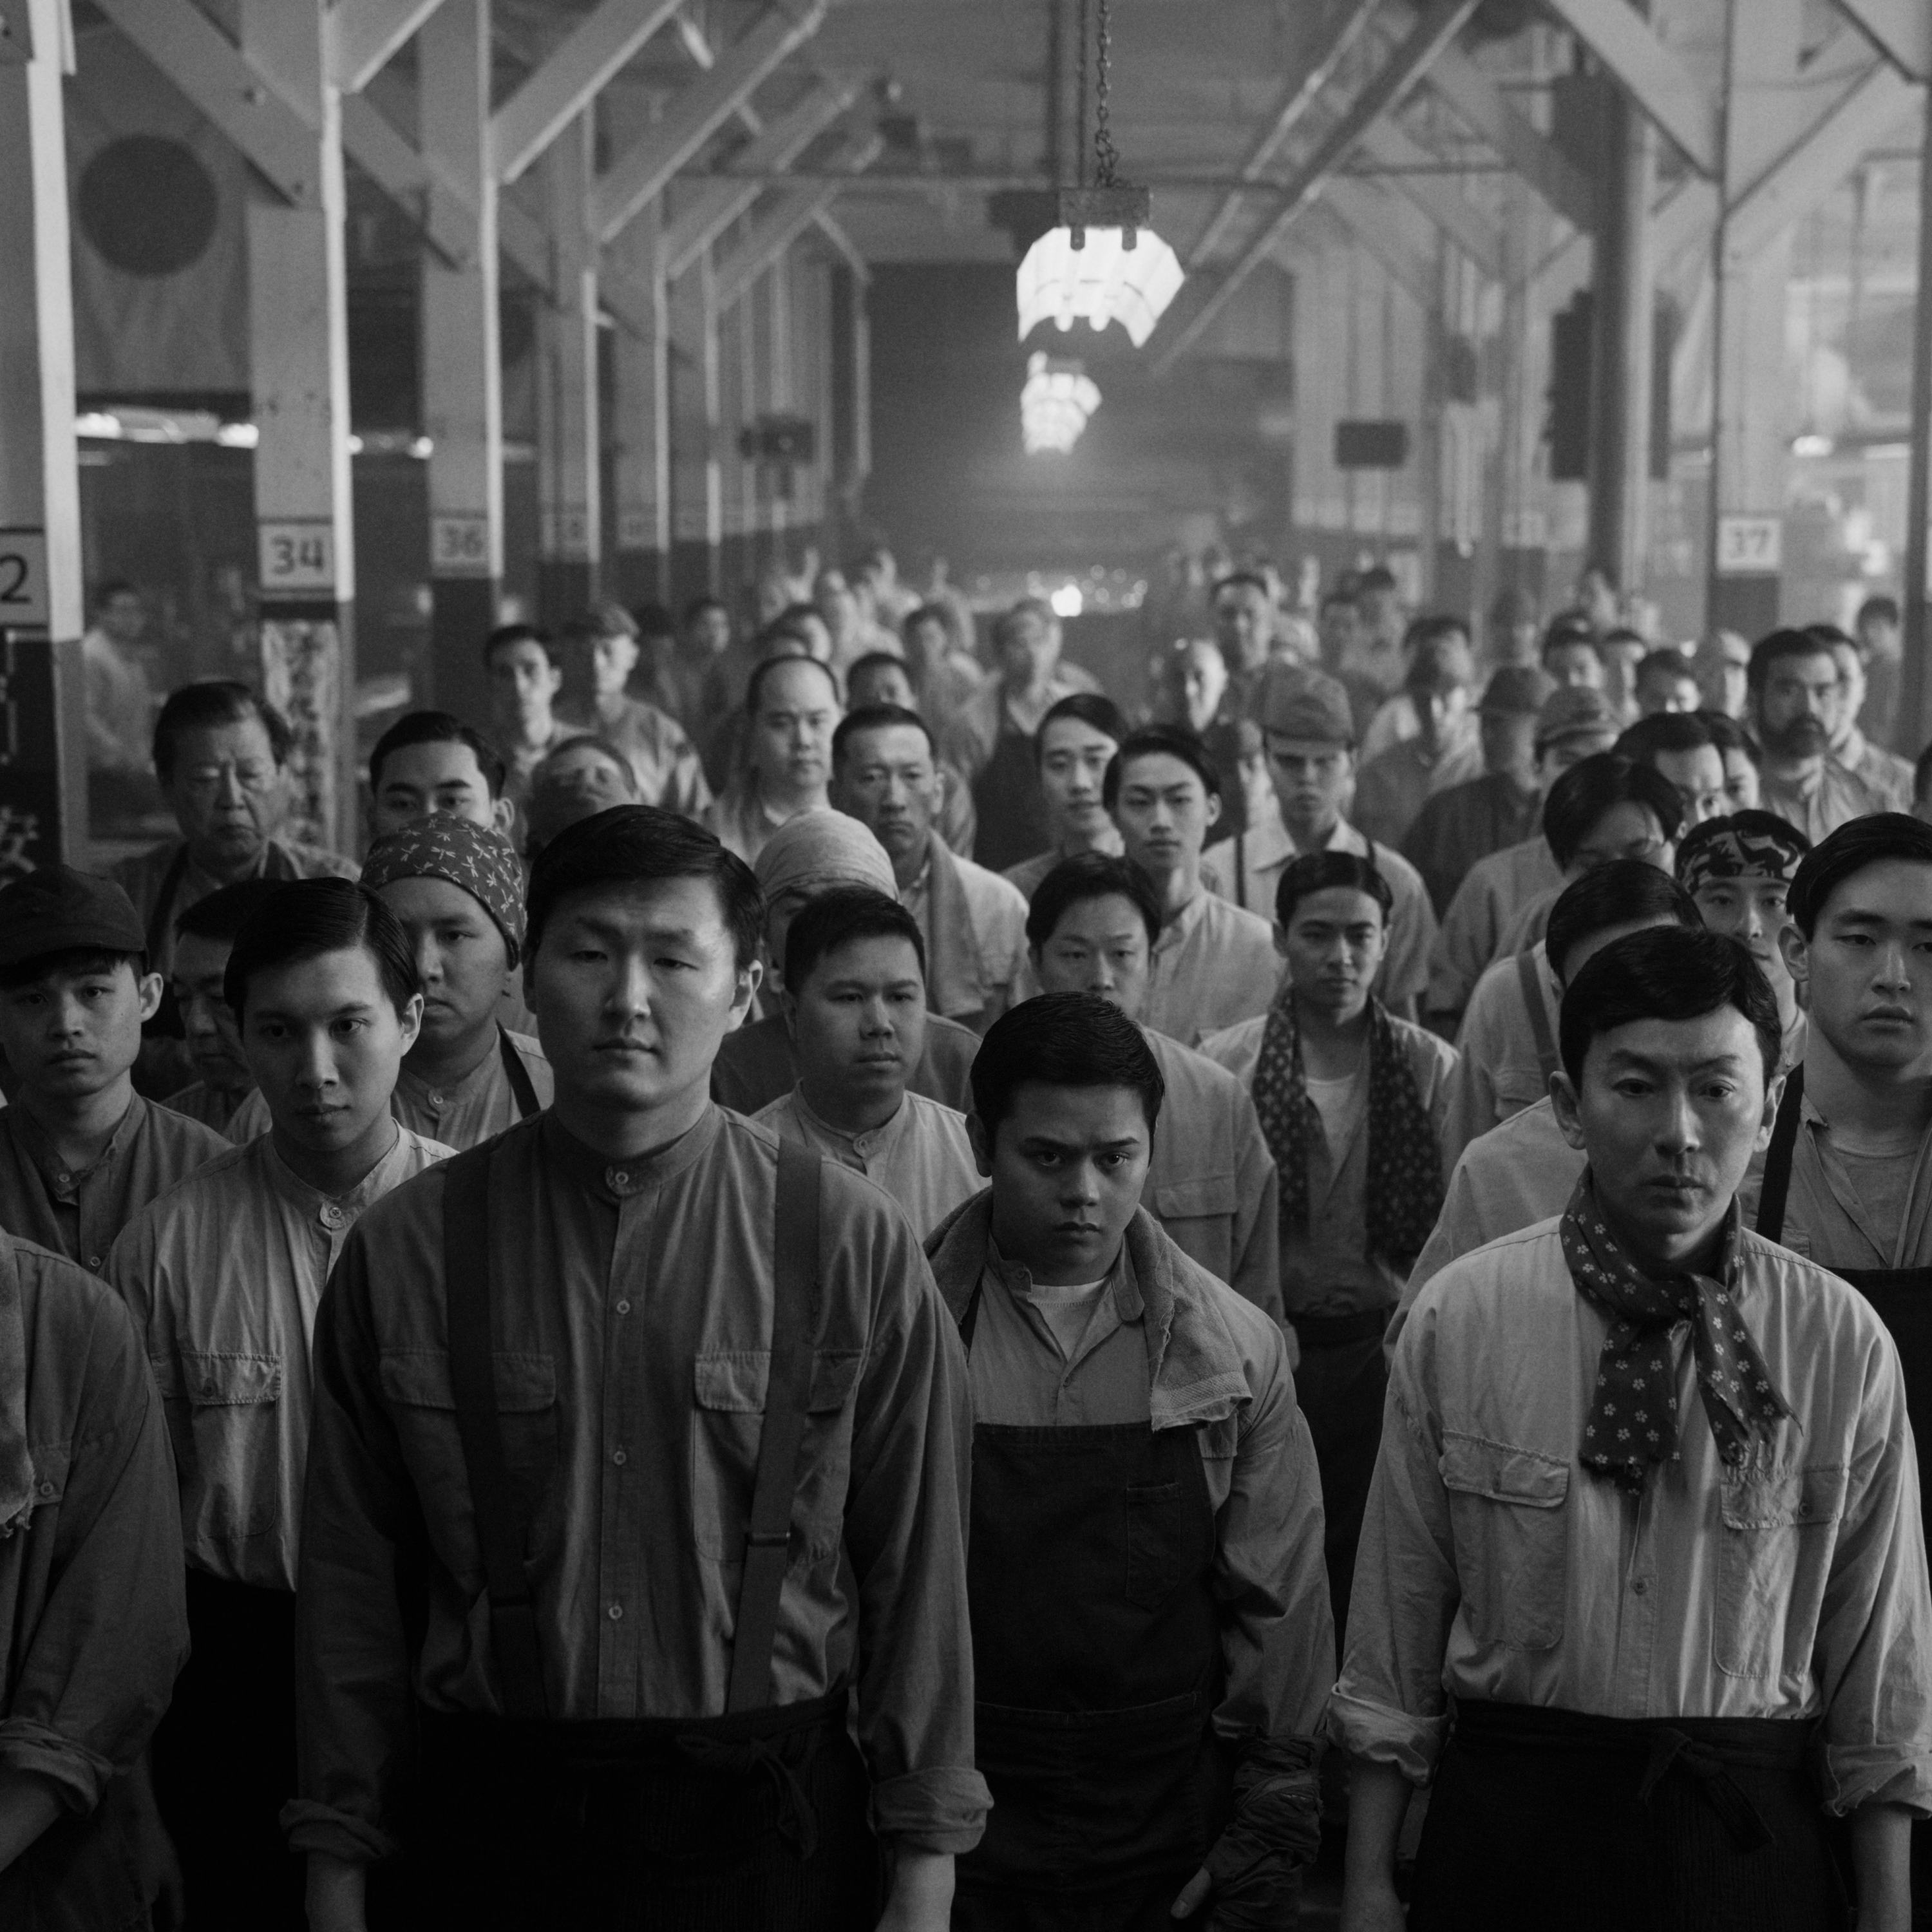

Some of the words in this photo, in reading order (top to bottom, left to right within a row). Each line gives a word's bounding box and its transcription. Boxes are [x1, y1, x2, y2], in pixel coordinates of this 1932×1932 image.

[270, 535, 324, 574] 34
[441, 526, 483, 558] 36
[0, 554, 32, 604] 2
